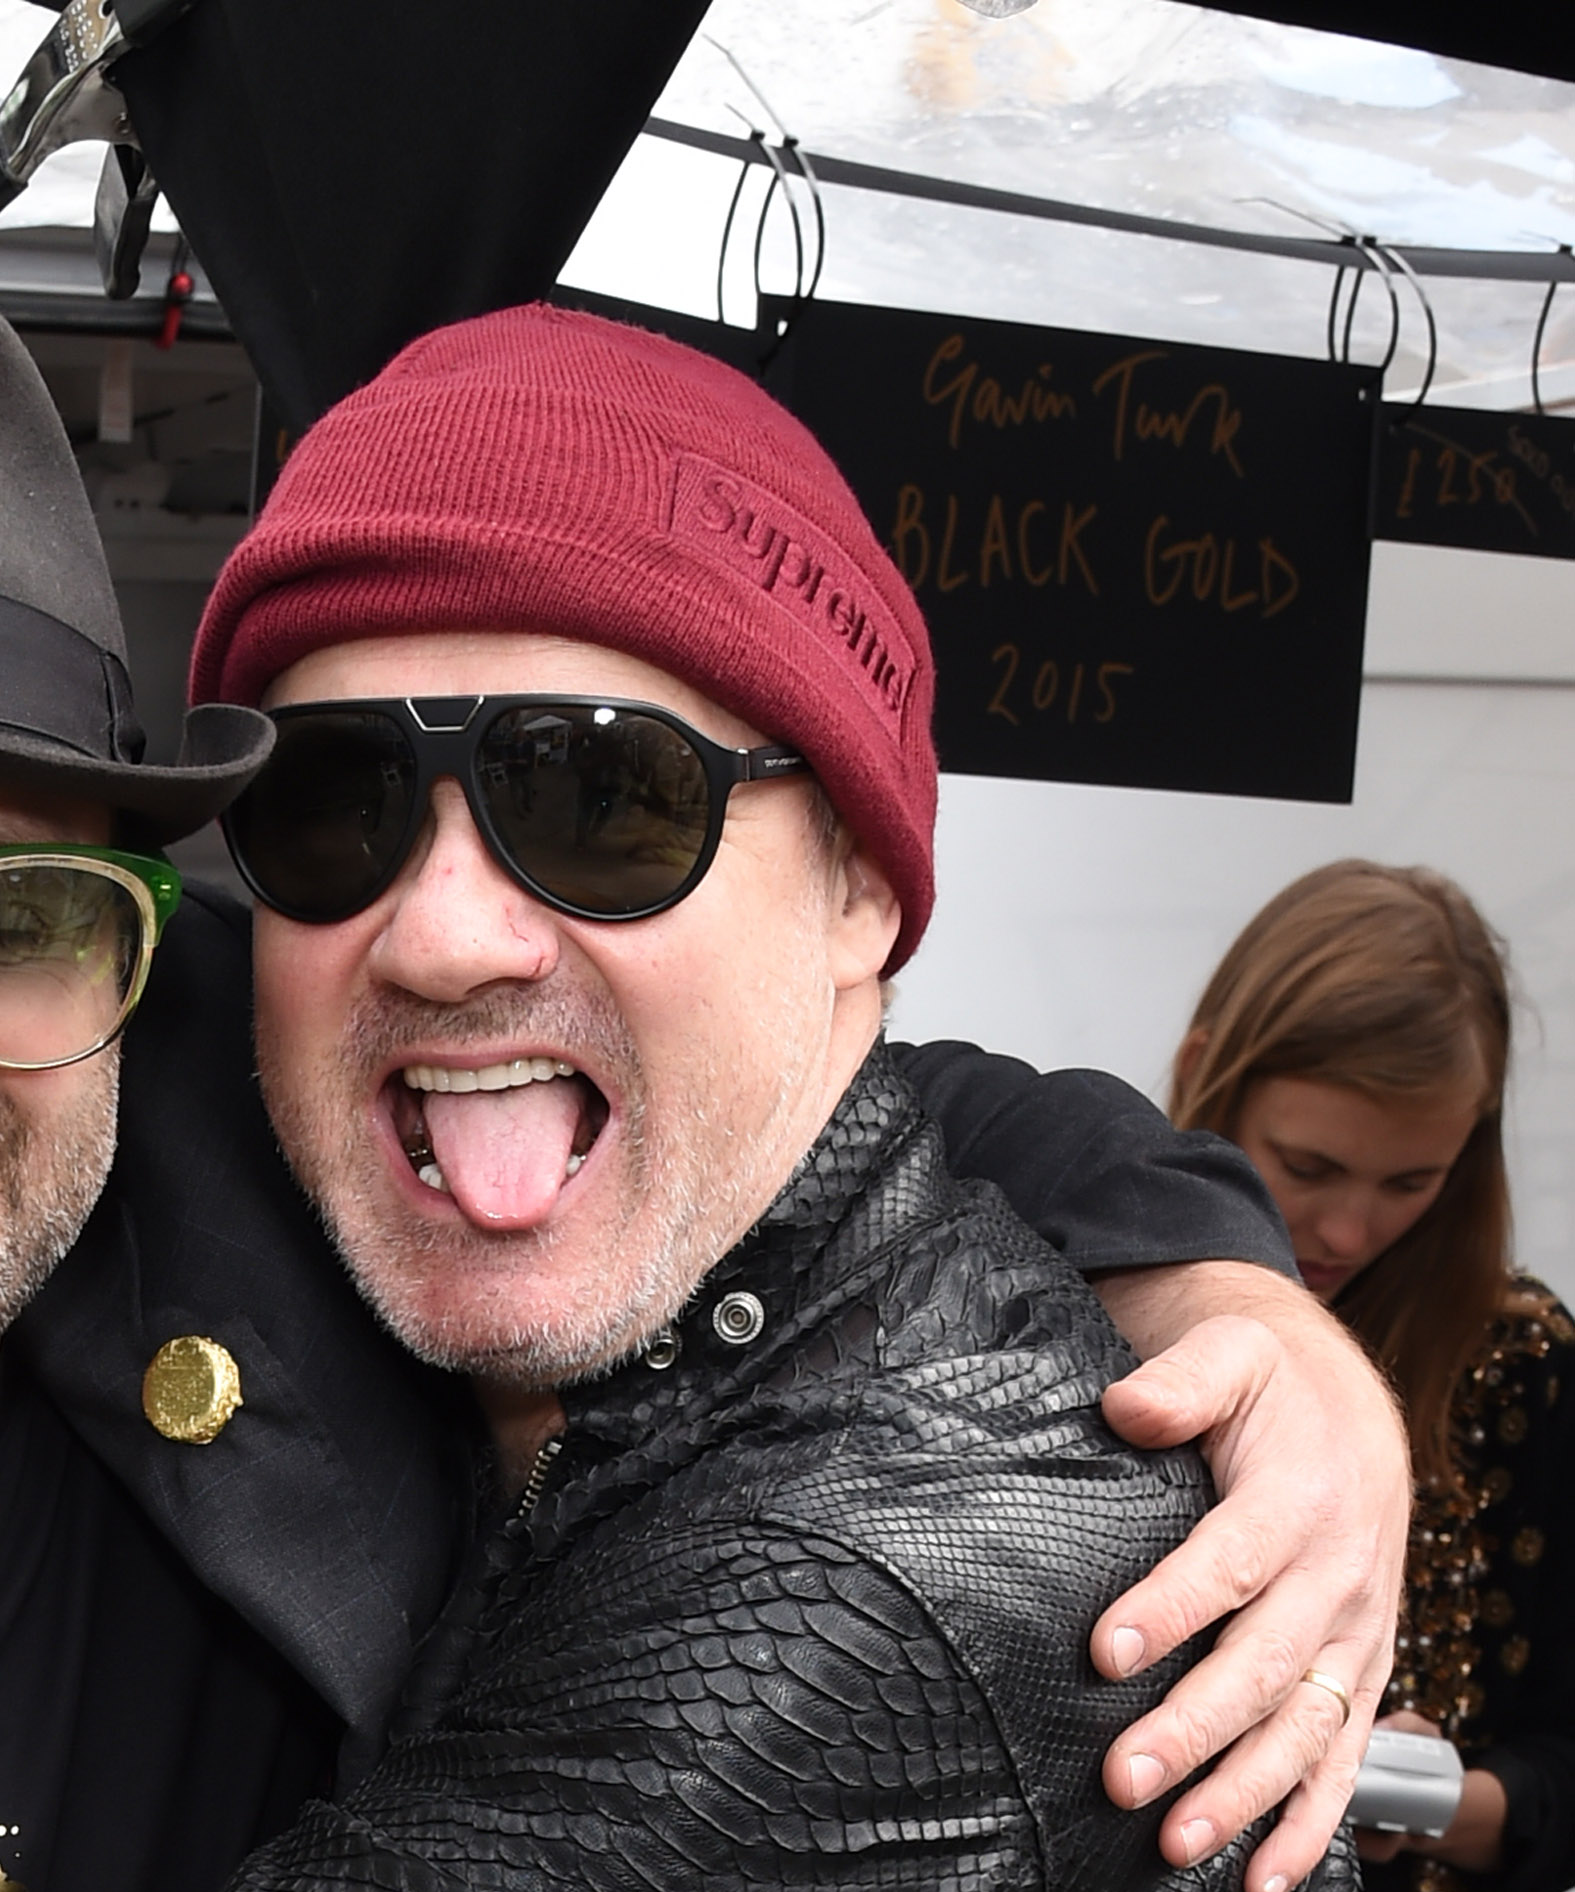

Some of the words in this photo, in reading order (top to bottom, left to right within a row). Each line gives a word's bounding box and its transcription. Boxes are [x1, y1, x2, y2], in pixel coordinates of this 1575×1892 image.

[923, 332, 1077, 450] Gavin
[1092, 348, 1247, 479] Turk
[695, 474, 908, 712] Supreme
[892, 482, 1100, 597] BLACK
[1143, 514, 1300, 620] GOLD
[986, 642, 1135, 727] 2015
